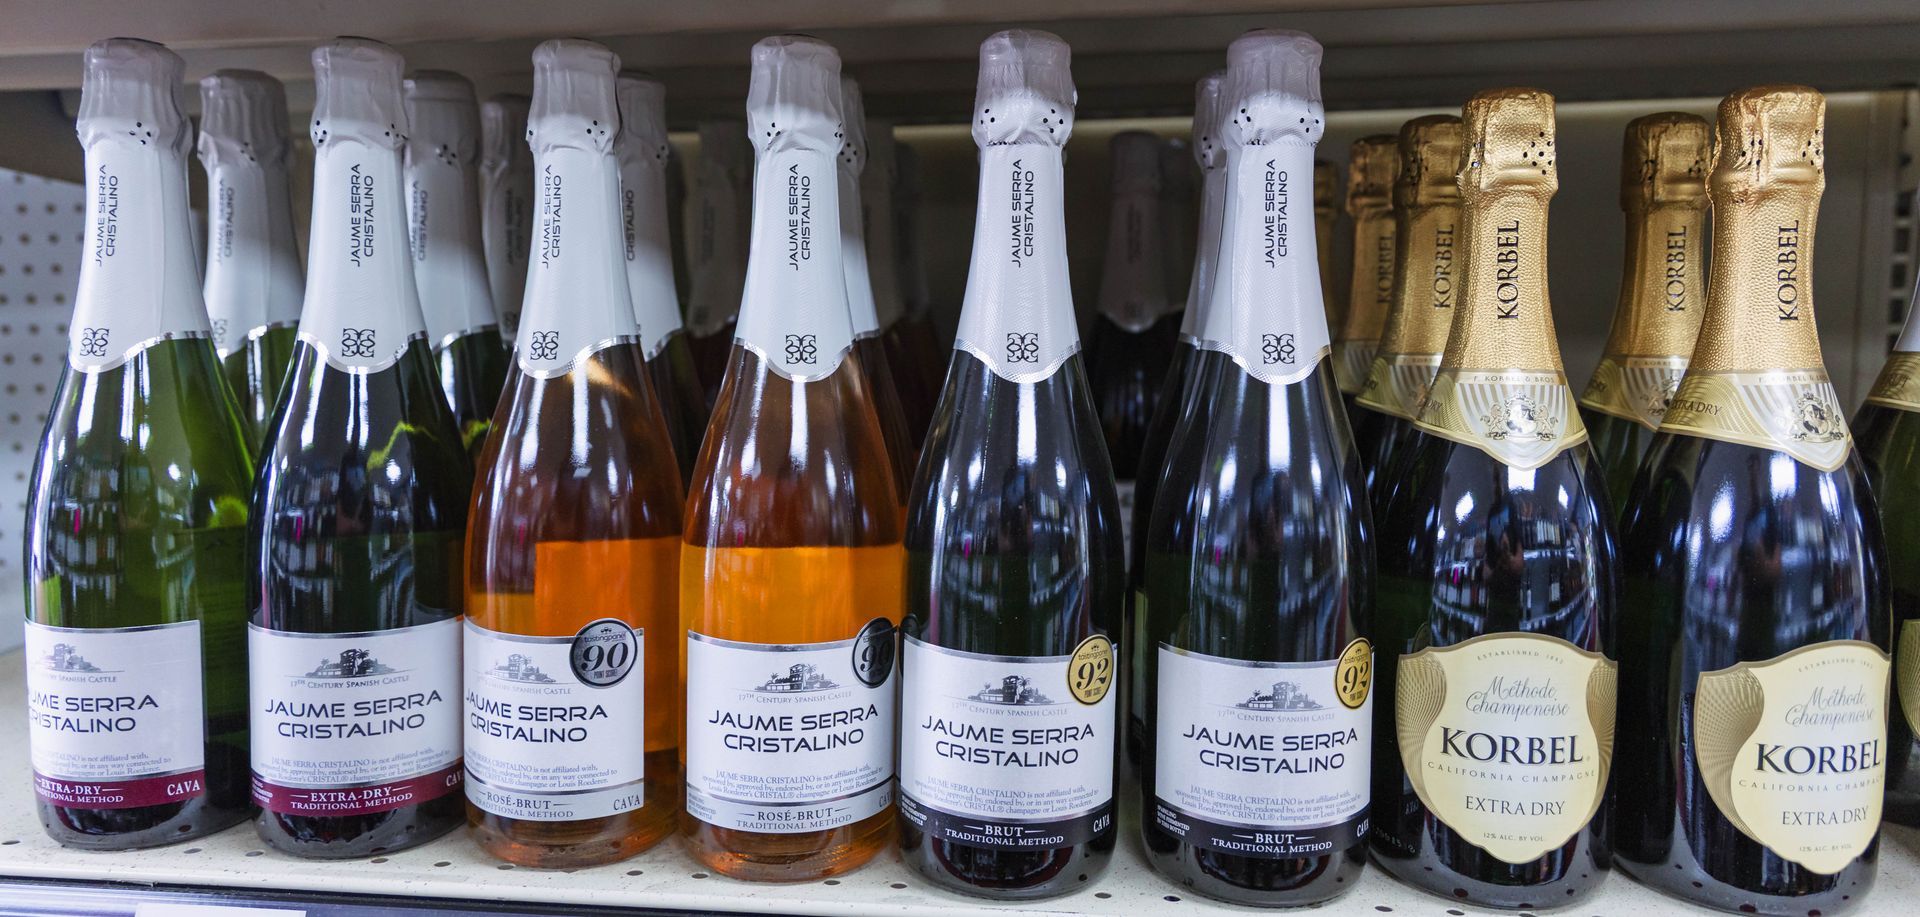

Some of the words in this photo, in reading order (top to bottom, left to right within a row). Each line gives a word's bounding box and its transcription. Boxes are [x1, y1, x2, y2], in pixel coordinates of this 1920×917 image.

[98, 164, 107, 214] SERRA
[351, 163, 360, 214] SERRA
[544, 164, 552, 216] SERRA
[789, 163, 799, 216] SERRA
[1012, 158, 1022, 211] SERRA
[1265, 159, 1276, 212] SERRA
[105, 175, 119, 257] CRISTALINO
[224, 187, 235, 258] CRISTALINO
[364, 175, 374, 257] CRISTALINO
[418, 189, 429, 262] CRISTALINO
[551, 175, 562, 258] CRISTALINO
[626, 189, 636, 262] CRISTALINO
[801, 175, 811, 261] CRISTALINO
[1024, 170, 1034, 257] CRISTALINO
[1277, 170, 1288, 257] CRISTALINO
[95, 217, 104, 267] JAUME
[351, 216, 361, 267] JAUME
[541, 218, 551, 269] JAUME
[789, 219, 799, 271] JAUME
[1012, 215, 1022, 268] JAUME
[1265, 215, 1275, 268] JAUME
[1434, 223, 1454, 310] KORBEL
[1497, 219, 1519, 321] KORBEL
[1666, 225, 1687, 312] KORBEL
[1777, 219, 1799, 322] KORBEL
[1696, 401, 1723, 416] DRY
[581, 642, 628, 671] 90
[307, 681, 344, 689] CENTURY
[346, 679, 380, 688] SPANISH
[1076, 657, 1109, 690] 92
[1342, 661, 1369, 694] 92
[65, 694, 159, 712] SERRA
[265, 699, 345, 718] JAUME
[354, 689, 443, 717] SERRA
[466, 688, 511, 718] JAUME
[518, 704, 608, 721] SERRA
[544, 687, 571, 695] CASTLE
[757, 695, 792, 704] CENTURY
[794, 694, 826, 704] SPANISH
[709, 710, 793, 731] JAUME
[801, 703, 878, 731] SERRA
[969, 705, 1005, 716] CENTURY
[1007, 708, 1040, 717] SPANISH
[1237, 712, 1275, 723] CENTURY
[1277, 714, 1309, 723] SPANISH
[1465, 690, 1570, 722] Champenoise
[278, 713, 425, 739] CRISTALINO
[471, 712, 588, 743] CRISTALINO
[921, 715, 1004, 744] JAUME
[1012, 724, 1095, 745] SERRA
[1183, 724, 1274, 751] JAUME
[1282, 727, 1358, 751] SERRA
[724, 728, 864, 753] CRISTALINO
[936, 740, 1079, 767] CRISTALINO
[1440, 726, 1584, 765] KORBEL
[1200, 750, 1345, 774] CRISTALINO
[1754, 738, 1881, 775] KORBEL
[445, 769, 464, 788] CAV
[739, 774, 764, 783] SERRA
[766, 776, 815, 784] CRISTALINO
[832, 767, 858, 779] affiliated
[1427, 761, 1514, 782] CALIFORNIA
[1522, 770, 1596, 783] CHAMPAGNE
[1738, 779, 1829, 792] CALIFORNIA
[41, 779, 101, 796] EXTRA-DRY
[77, 795, 124, 804] METHOD
[167, 780, 201, 796] CAVA
[290, 801, 362, 810] TRADITIONAL
[365, 792, 413, 809] METHOD
[310, 786, 392, 802] EXTRA-DRY
[487, 791, 552, 809] ROSÉ-BRUT
[736, 783, 763, 792] approved
[528, 809, 573, 818] METHOD
[613, 795, 640, 811] CAVA
[757, 806, 834, 822] ROSÉ-BRUT
[1465, 795, 1526, 816] EXTRA
[1530, 799, 1566, 816] DRY
[1782, 810, 1838, 826] EXTRA
[1842, 805, 1869, 823] DRY
[736, 819, 805, 831] TRADITIONAL
[809, 814, 852, 829] METHOD
[985, 825, 1024, 837] BRUT
[1093, 813, 1110, 833] CAVA
[945, 828, 1015, 846] TRADITIONAL
[1018, 835, 1064, 846] METHOD
[1211, 837, 1286, 853] TRADITIONAL
[1289, 841, 1333, 853] METHOD
[1255, 833, 1295, 844] BRUT
